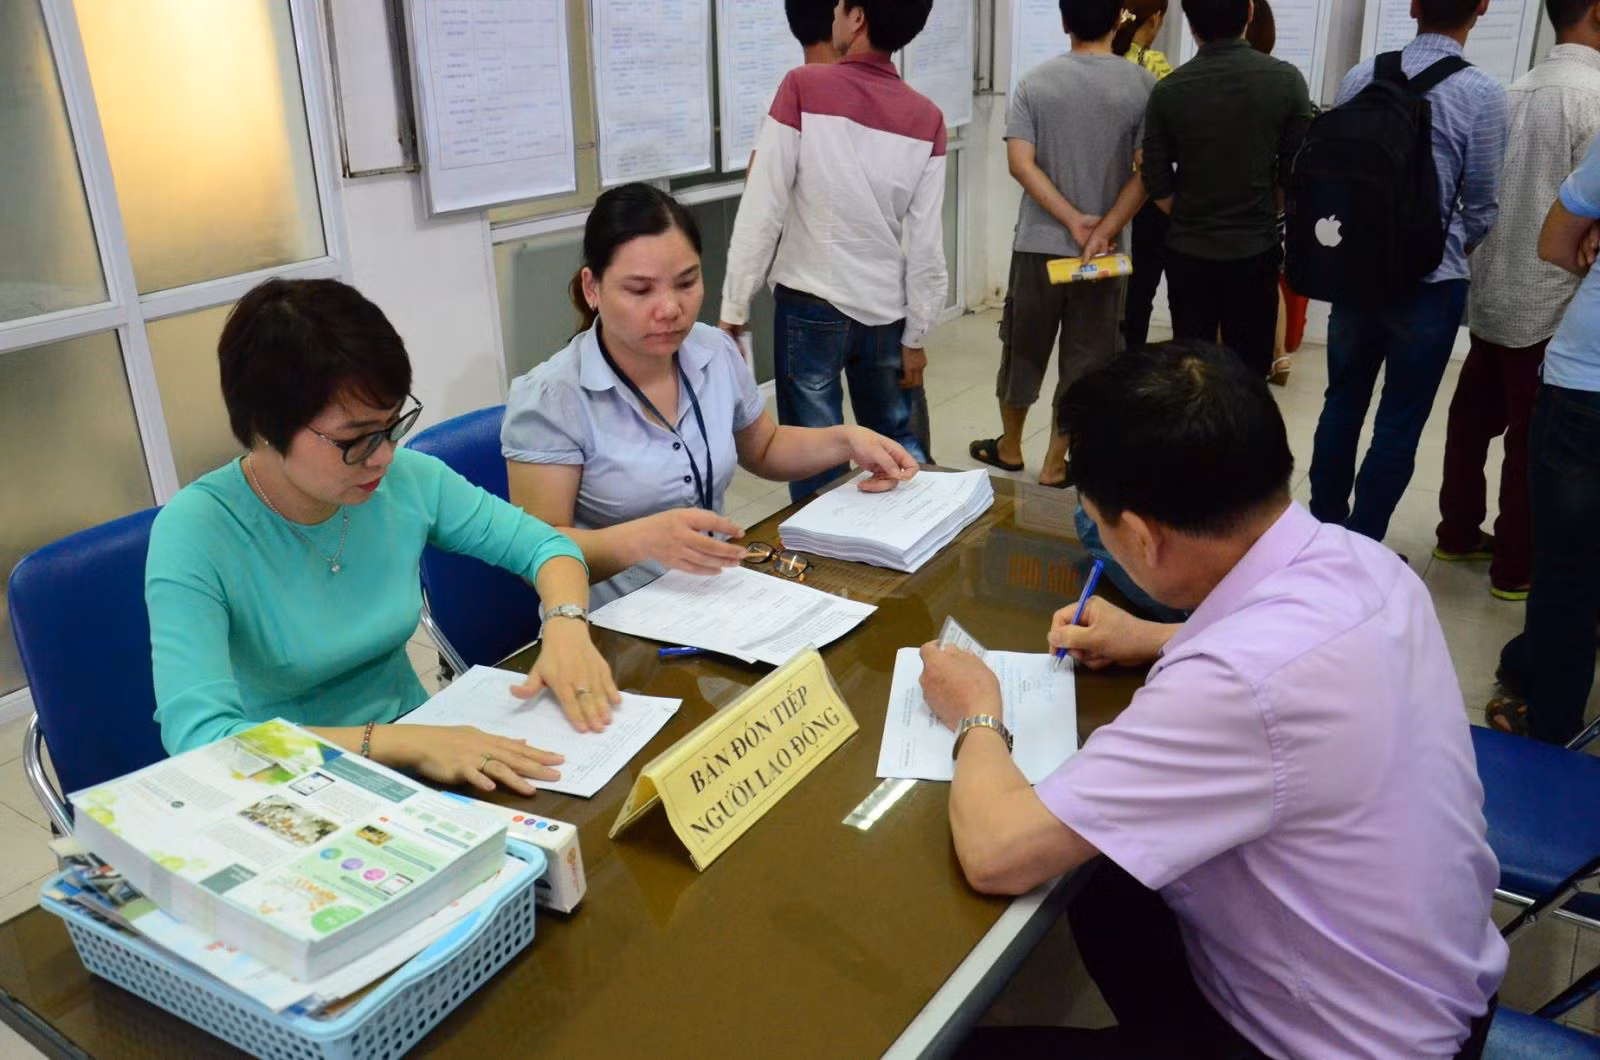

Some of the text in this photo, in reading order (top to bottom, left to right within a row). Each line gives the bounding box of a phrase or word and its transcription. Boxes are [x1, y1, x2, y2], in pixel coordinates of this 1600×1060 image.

[689, 683, 808, 794] BÀN ĐÓN TIẾP
[690, 778, 757, 843] NGƯỜI
[754, 748, 793, 789] LAO
[789, 706, 841, 757] ĐỘNG
